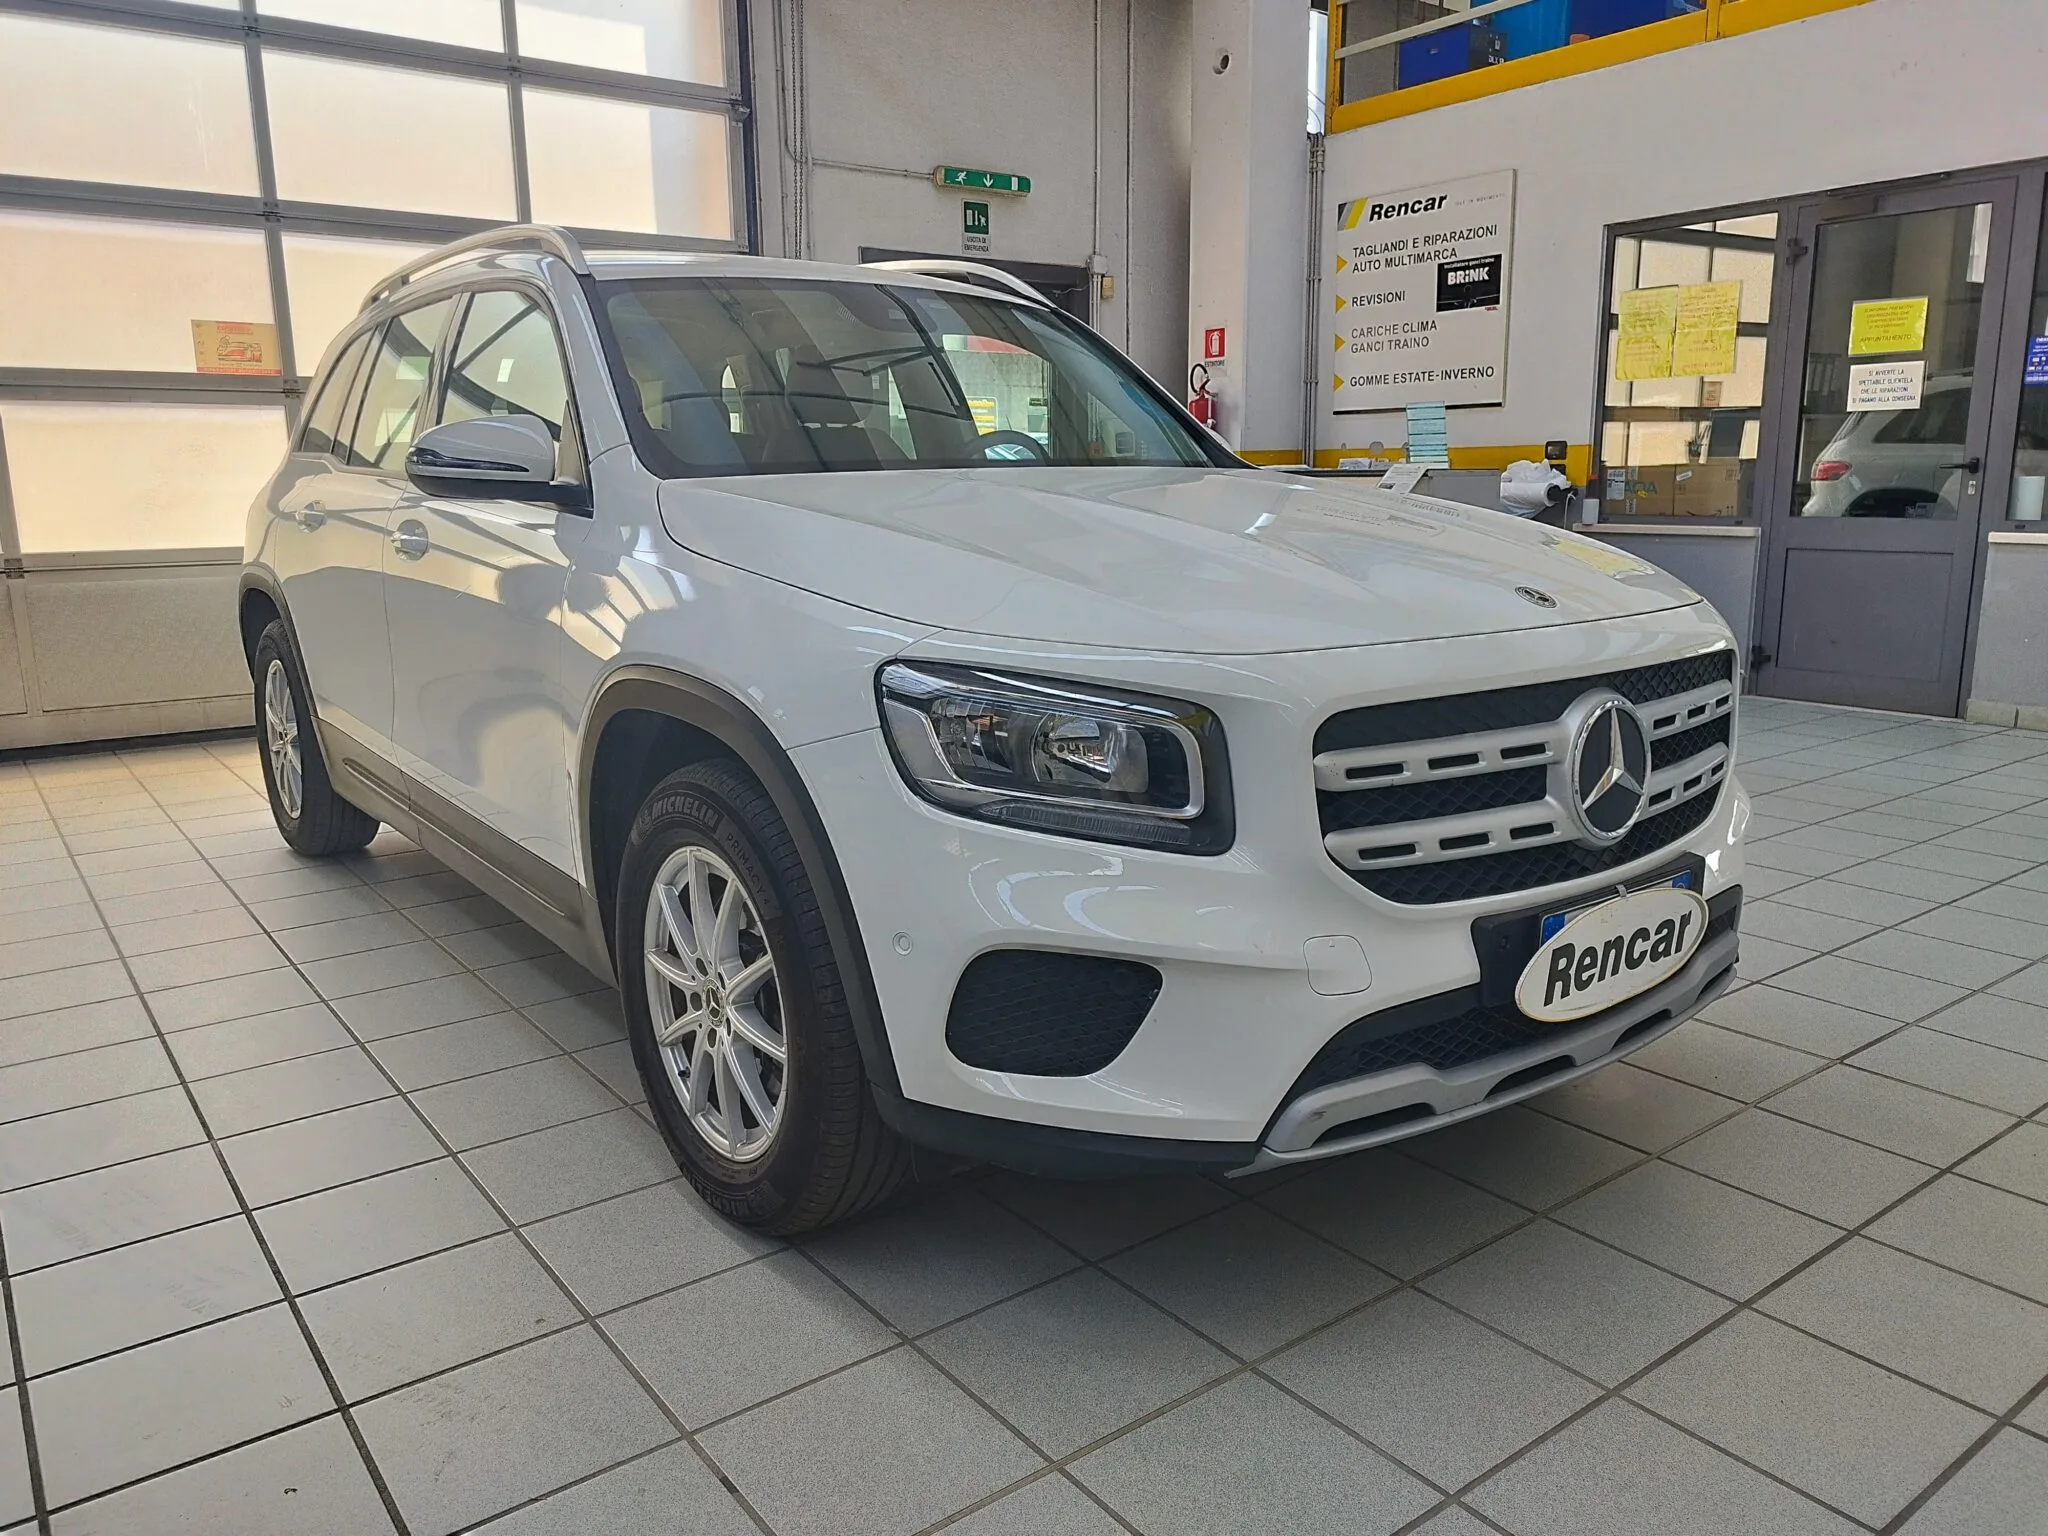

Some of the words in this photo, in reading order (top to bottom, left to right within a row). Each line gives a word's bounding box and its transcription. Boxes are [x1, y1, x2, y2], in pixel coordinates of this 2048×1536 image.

[1368, 194, 1448, 223] Rencar
[964, 244, 989, 252] EMERGENZA
[966, 236, 981, 244] USCITA
[1352, 240, 1408, 258] TAGLIANDI
[1412, 237, 1420, 249] E
[1423, 224, 1497, 247] RIPARAZIONI
[1352, 259, 1381, 273] AUTO
[1385, 247, 1458, 269] MULTIMARCA
[1351, 290, 1406, 307] REVISIONI
[1351, 323, 1399, 339] CARICHE
[1402, 320, 1438, 333] CLIMA
[1351, 340, 1384, 353] GANCI
[1388, 336, 1430, 350] TRAINO
[1204, 360, 1225, 368] ESTINTORE
[1350, 374, 1390, 387] GOMME
[1393, 366, 1495, 384] ESTATE-INVERNO
[1887, 377, 1913, 385] CLIENTELA
[651, 795, 719, 827] MICHELIN
[725, 833, 766, 893] PRIMACY
[1543, 909, 1692, 1008] Rencar
